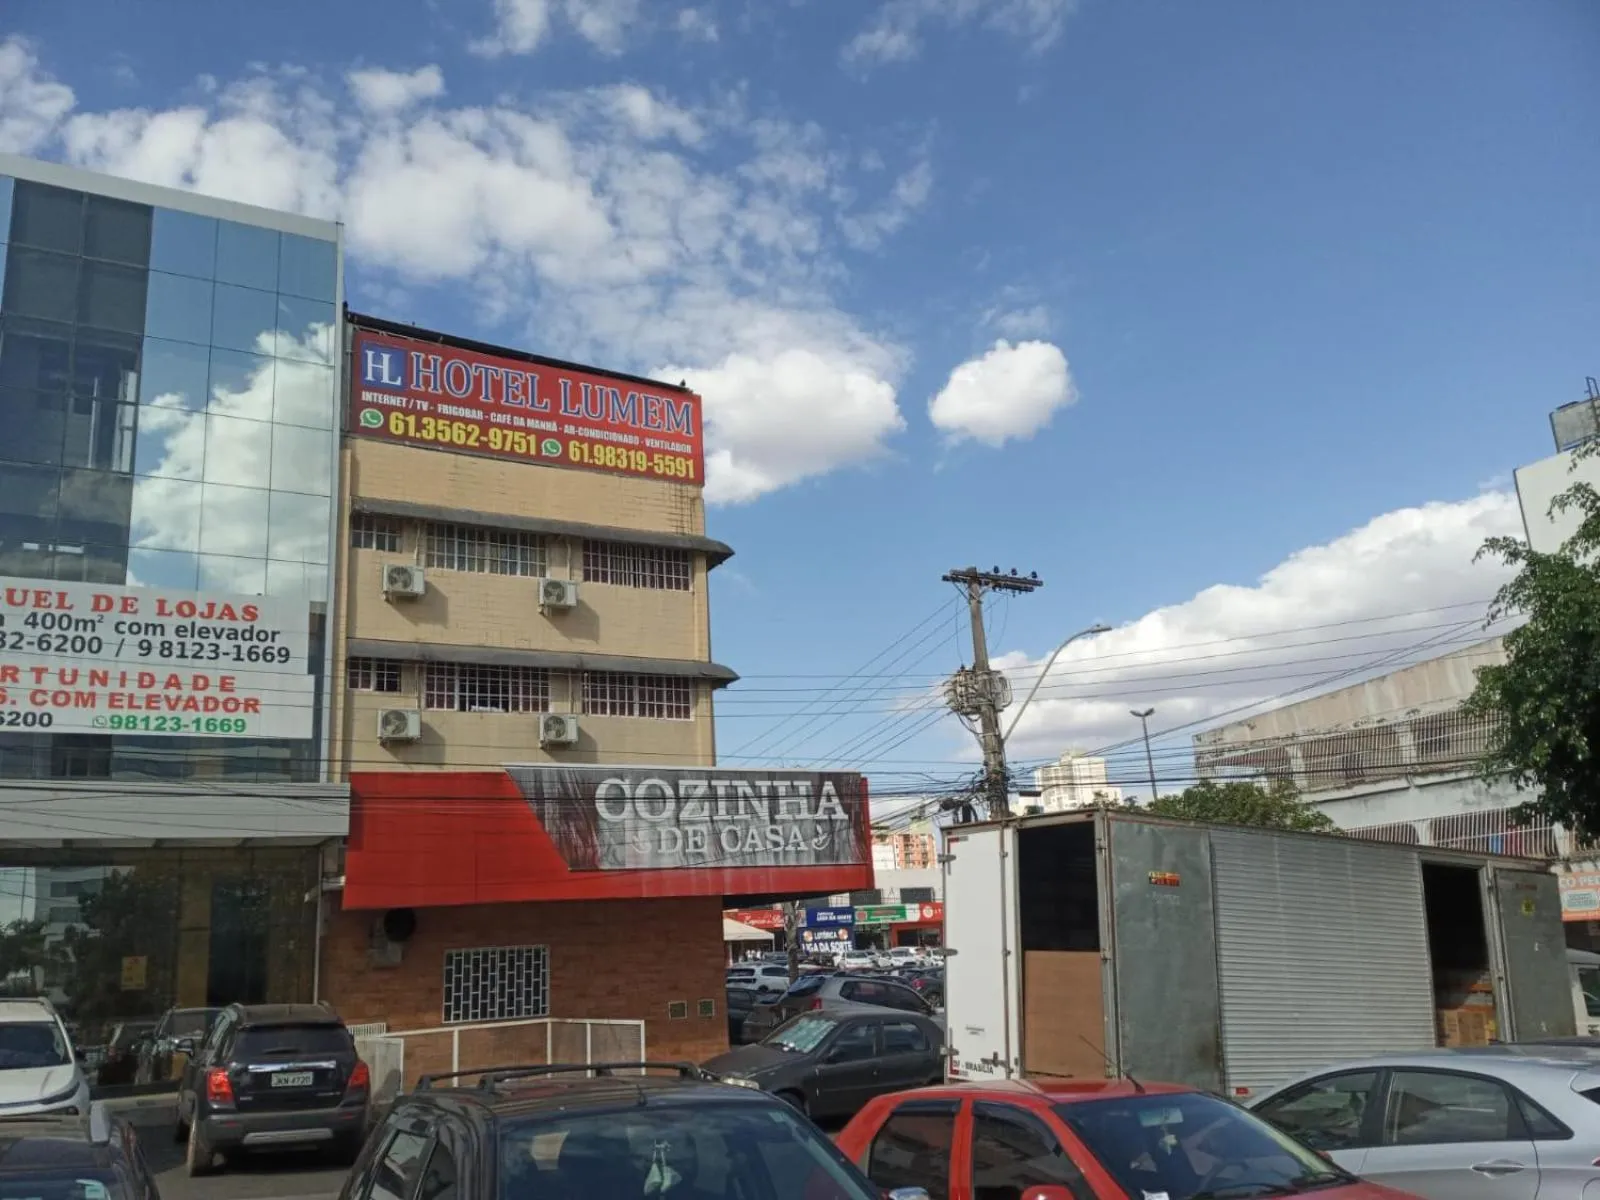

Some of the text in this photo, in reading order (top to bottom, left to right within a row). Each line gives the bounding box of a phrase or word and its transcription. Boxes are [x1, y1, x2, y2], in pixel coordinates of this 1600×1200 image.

[365, 350, 402, 385] HL
[411, 352, 694, 436] HOTEL LUMEM
[361, 390, 408, 408] INTERNET
[416, 399, 429, 411] TV
[438, 404, 483, 421] FRIGOBAR
[490, 412, 512, 425] CAFÉ
[513, 416, 526, 427] DA
[527, 417, 557, 433] MANHÃ
[564, 424, 639, 445] AR-CONDICIONADO
[645, 438, 692, 454] VENTILADOR
[389, 411, 537, 455] 61.3562-9751
[568, 439, 695, 479] 61.98319-5591
[0, 588, 259, 622] UEL DE LOJAS
[114, 619, 165, 637] com
[175, 621, 280, 643] elevador
[29, 689, 97, 710] COM
[108, 692, 261, 714] ELEVADOR
[109, 714, 247, 734] 98123-1669
[595, 778, 849, 822] COZINHA
[657, 824, 809, 854] DE CASA
